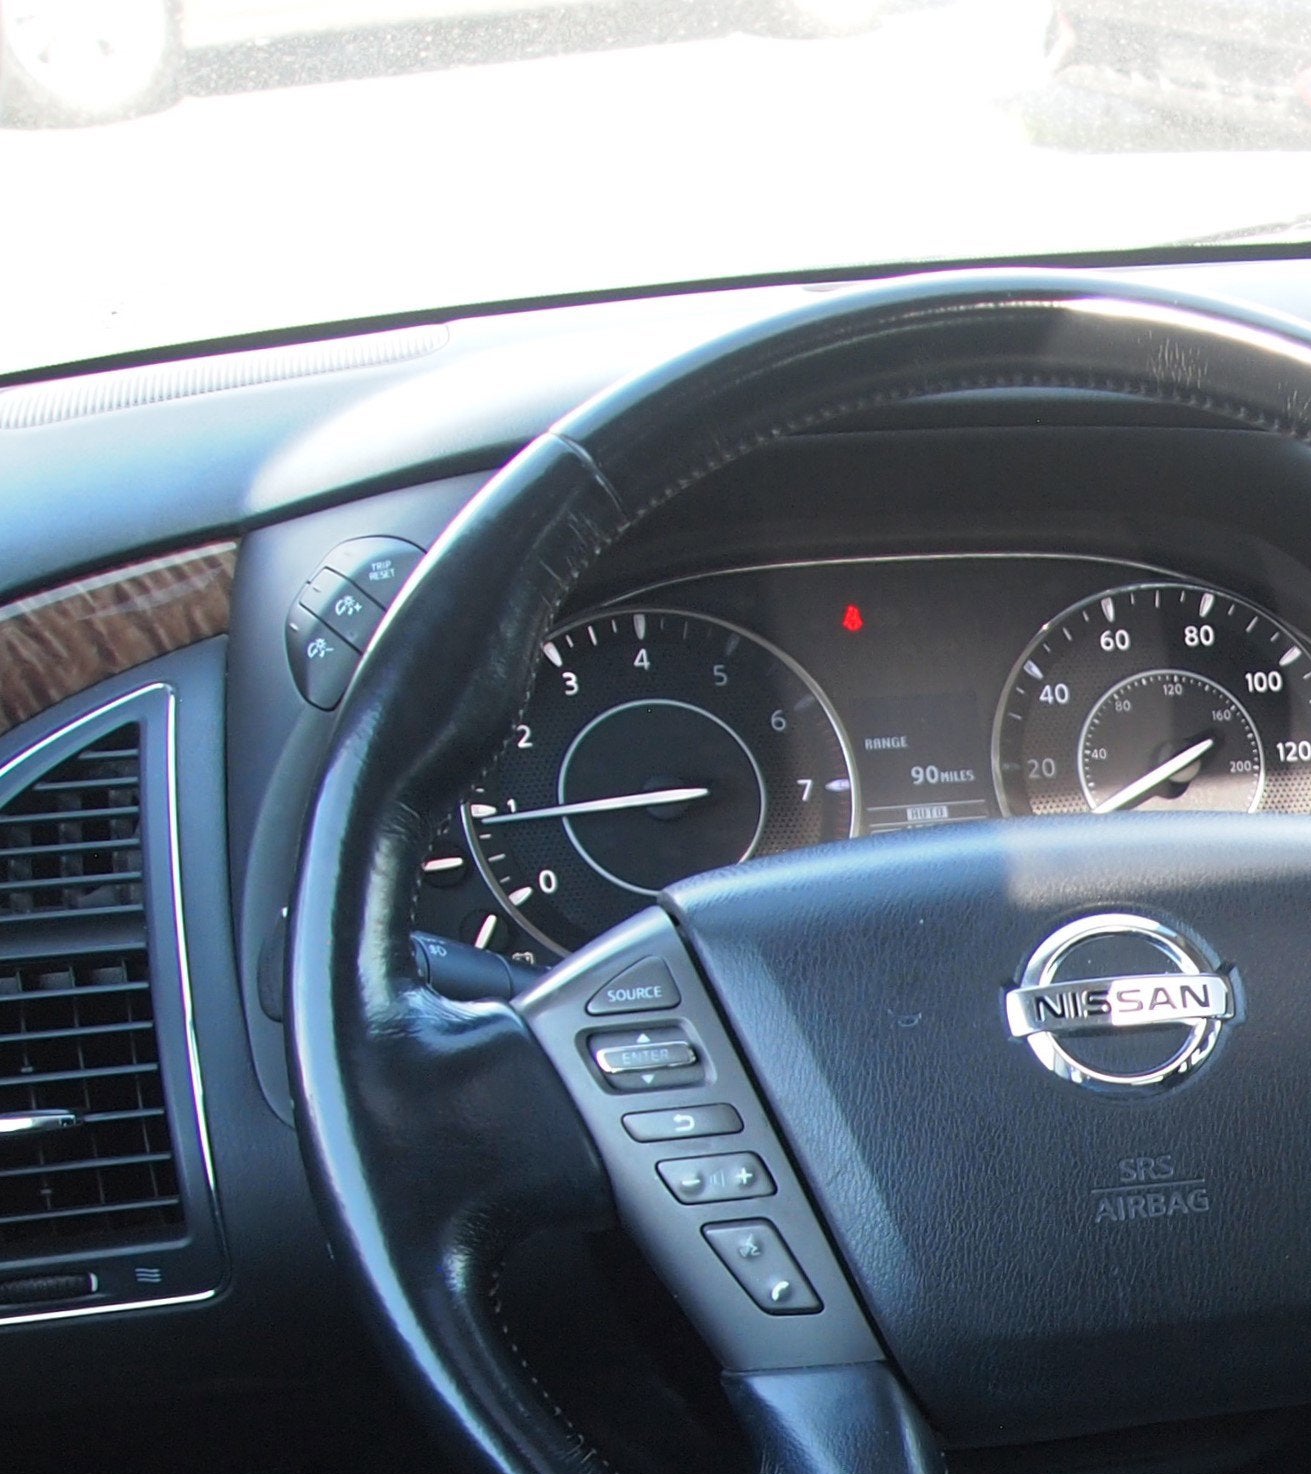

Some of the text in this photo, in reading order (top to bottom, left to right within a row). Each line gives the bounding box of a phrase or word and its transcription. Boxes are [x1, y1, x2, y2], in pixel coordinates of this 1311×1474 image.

[369, 568, 395, 581] RESET
[371, 560, 392, 571] TRIP
[1100, 629, 1130, 651] 60
[1184, 625, 1215, 647] 80
[634, 648, 650, 670] 4
[563, 672, 580, 695] 3
[713, 665, 728, 687] 5
[1245, 670, 1284, 693] 100
[1039, 682, 1070, 704] 40
[1163, 683, 1183, 697] 120
[1115, 698, 1131, 712] 80
[1211, 708, 1232, 722] 160
[770, 709, 787, 732] 6
[516, 725, 533, 748] 2
[864, 735, 908, 751] RANGE
[1091, 747, 1107, 760] 40
[1028, 758, 1056, 778] 20
[1229, 760, 1252, 773] 200
[797, 778, 814, 802] 7
[539, 870, 557, 893] 0
[607, 986, 663, 1002] SOURCE
[1034, 983, 1211, 1022] NISSAN
[622, 1049, 670, 1065] ENTER
[1118, 1155, 1174, 1183] SRS
[1095, 1189, 1210, 1223] AIRBAG
